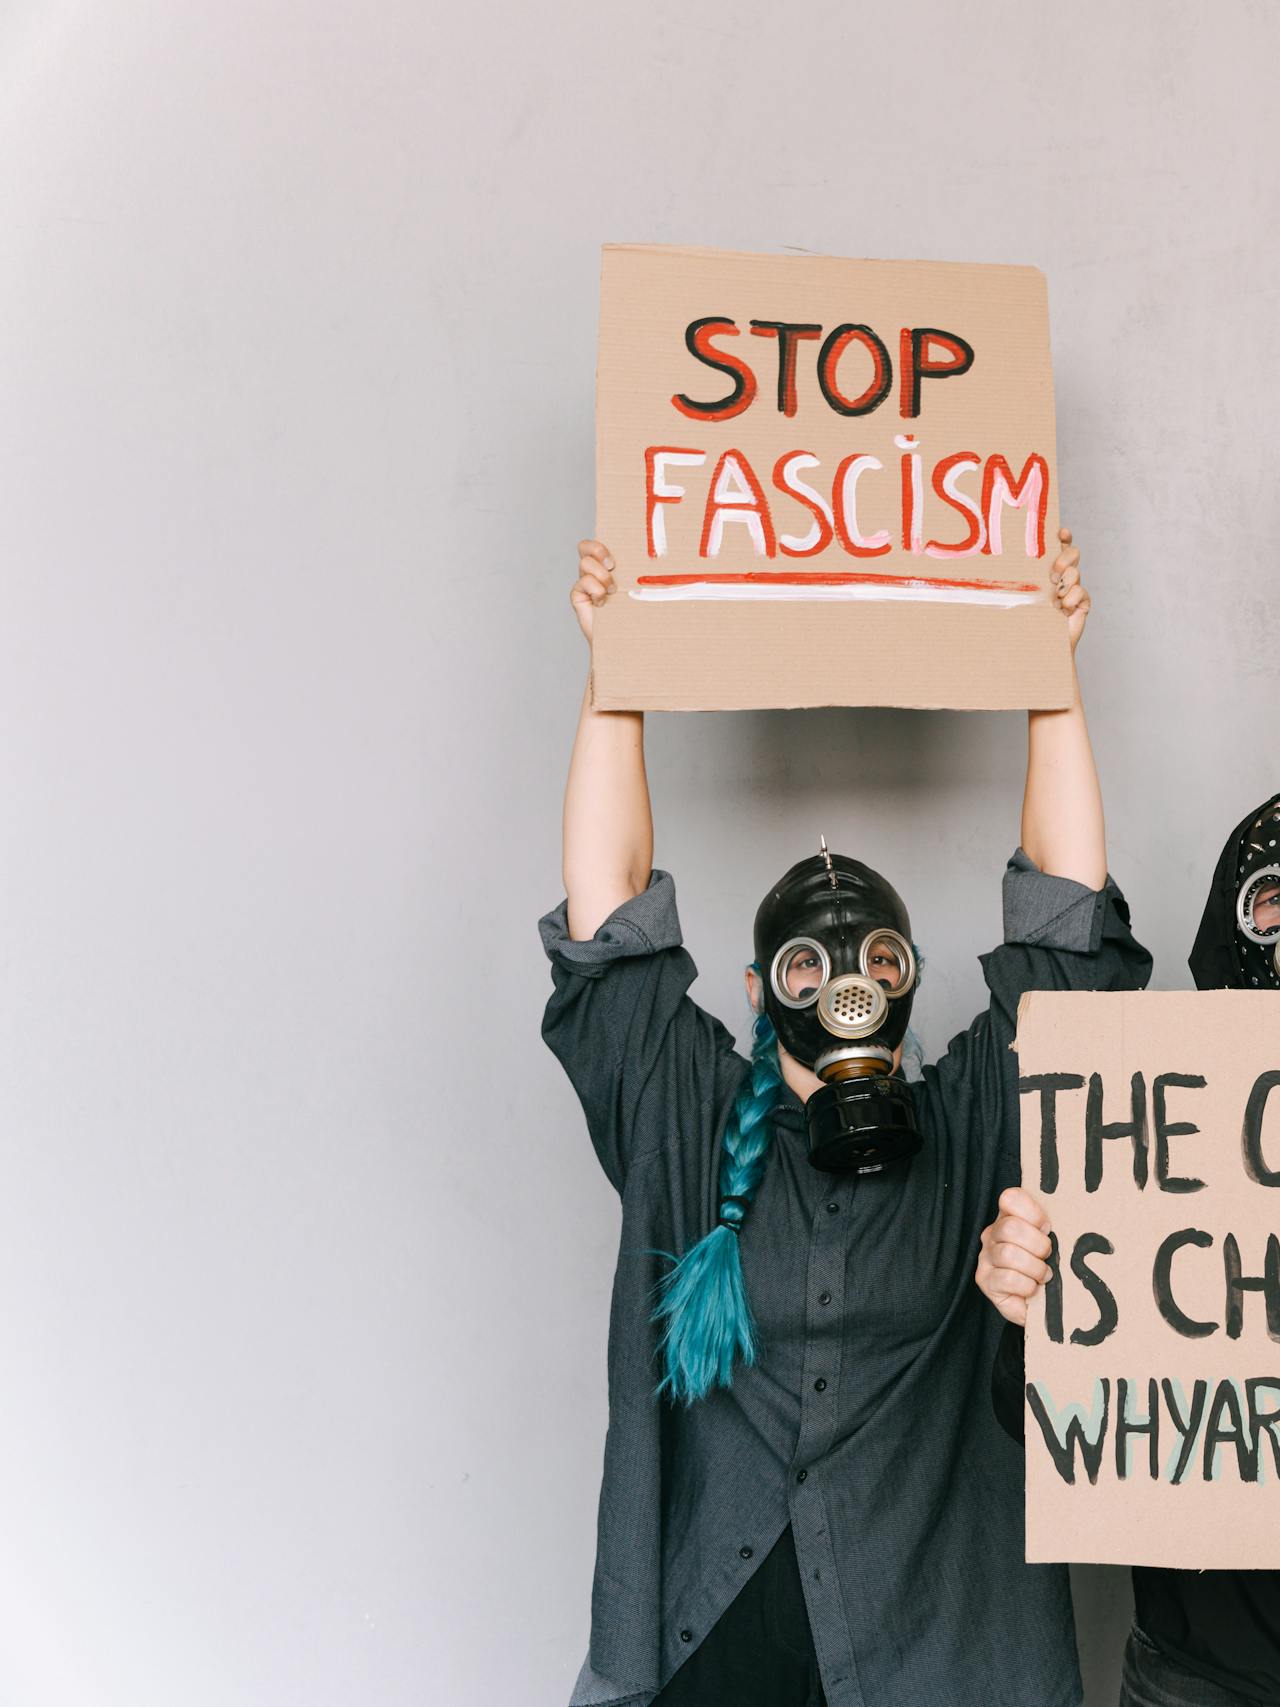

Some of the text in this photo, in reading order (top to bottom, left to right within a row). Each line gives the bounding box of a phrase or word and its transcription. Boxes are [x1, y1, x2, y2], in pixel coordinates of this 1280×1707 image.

[671, 316, 975, 423] STOP
[1019, 1070, 1208, 1195] THE
[1044, 1230, 1119, 1347] IS
